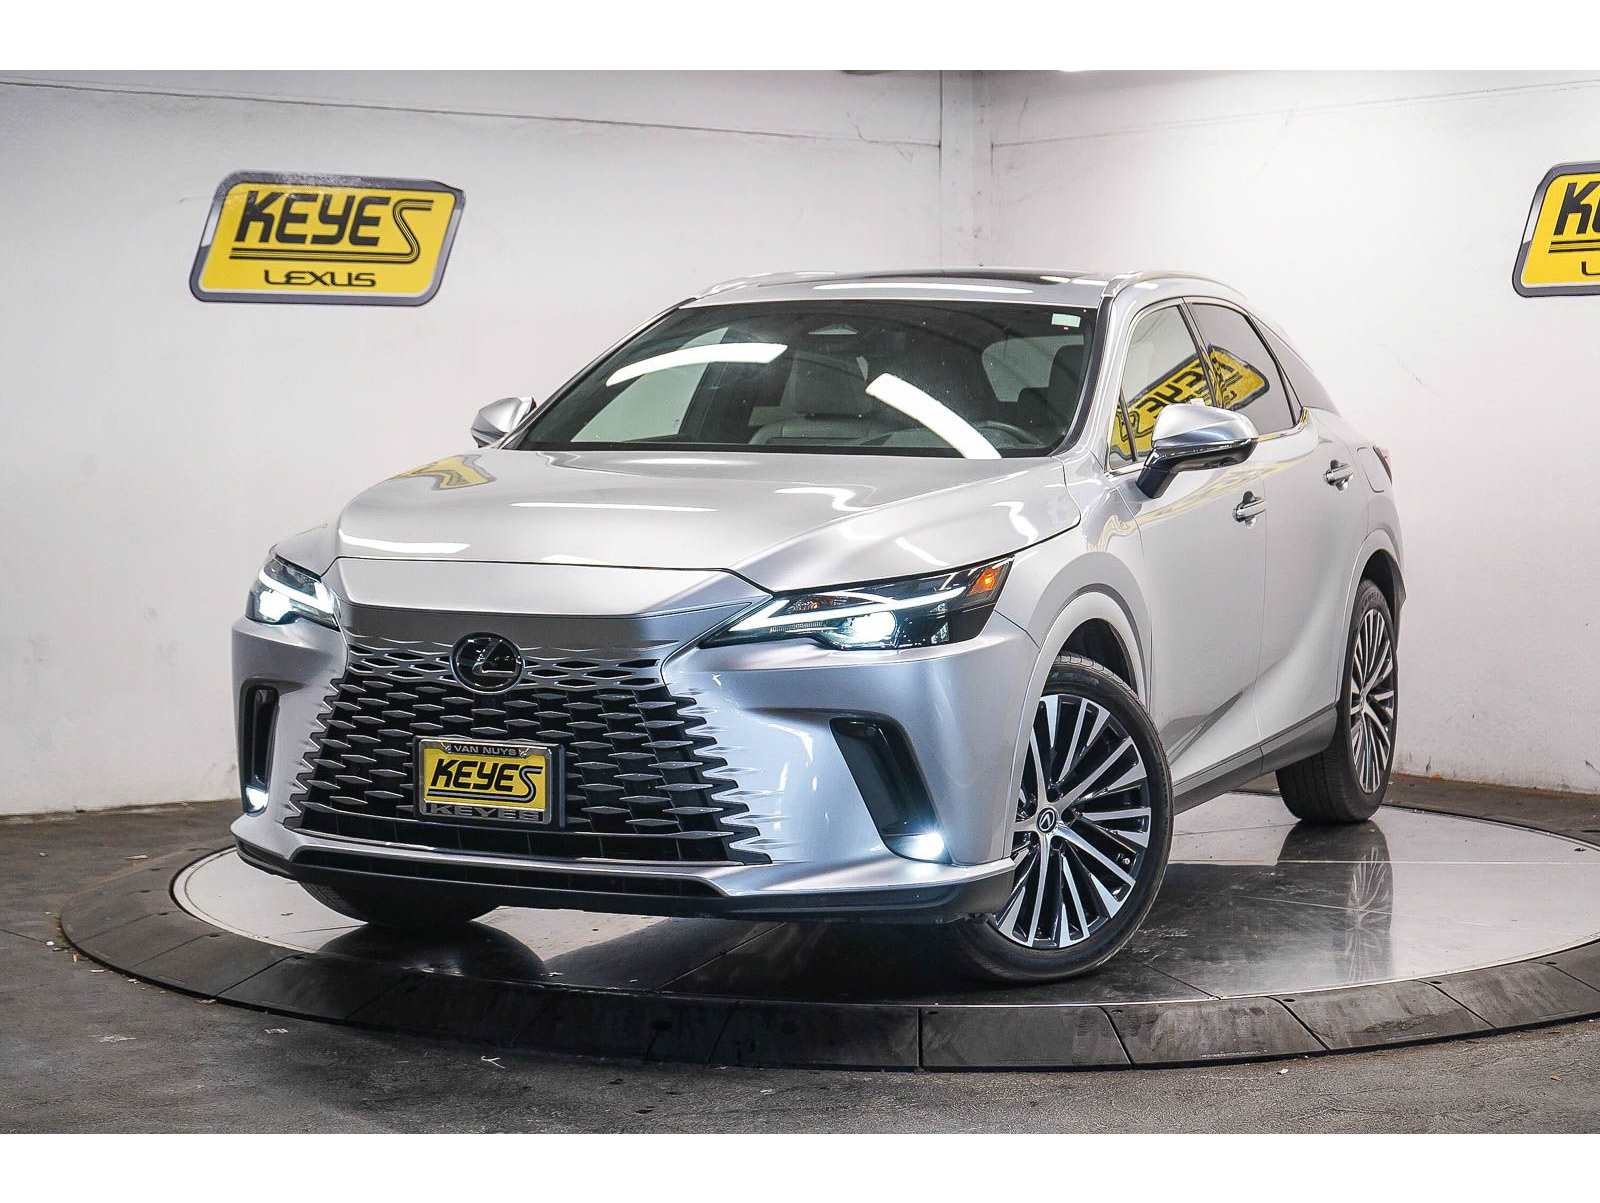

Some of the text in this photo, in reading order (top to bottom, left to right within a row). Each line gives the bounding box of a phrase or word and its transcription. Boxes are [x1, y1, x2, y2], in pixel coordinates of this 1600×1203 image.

[1553, 181, 1600, 235] K
[230, 190, 434, 263] KEYES
[264, 270, 376, 287] LEXUS
[454, 745, 517, 756] VAN NUYS
[427, 759, 543, 803] KEYES
[430, 804, 540, 821] KEYES
